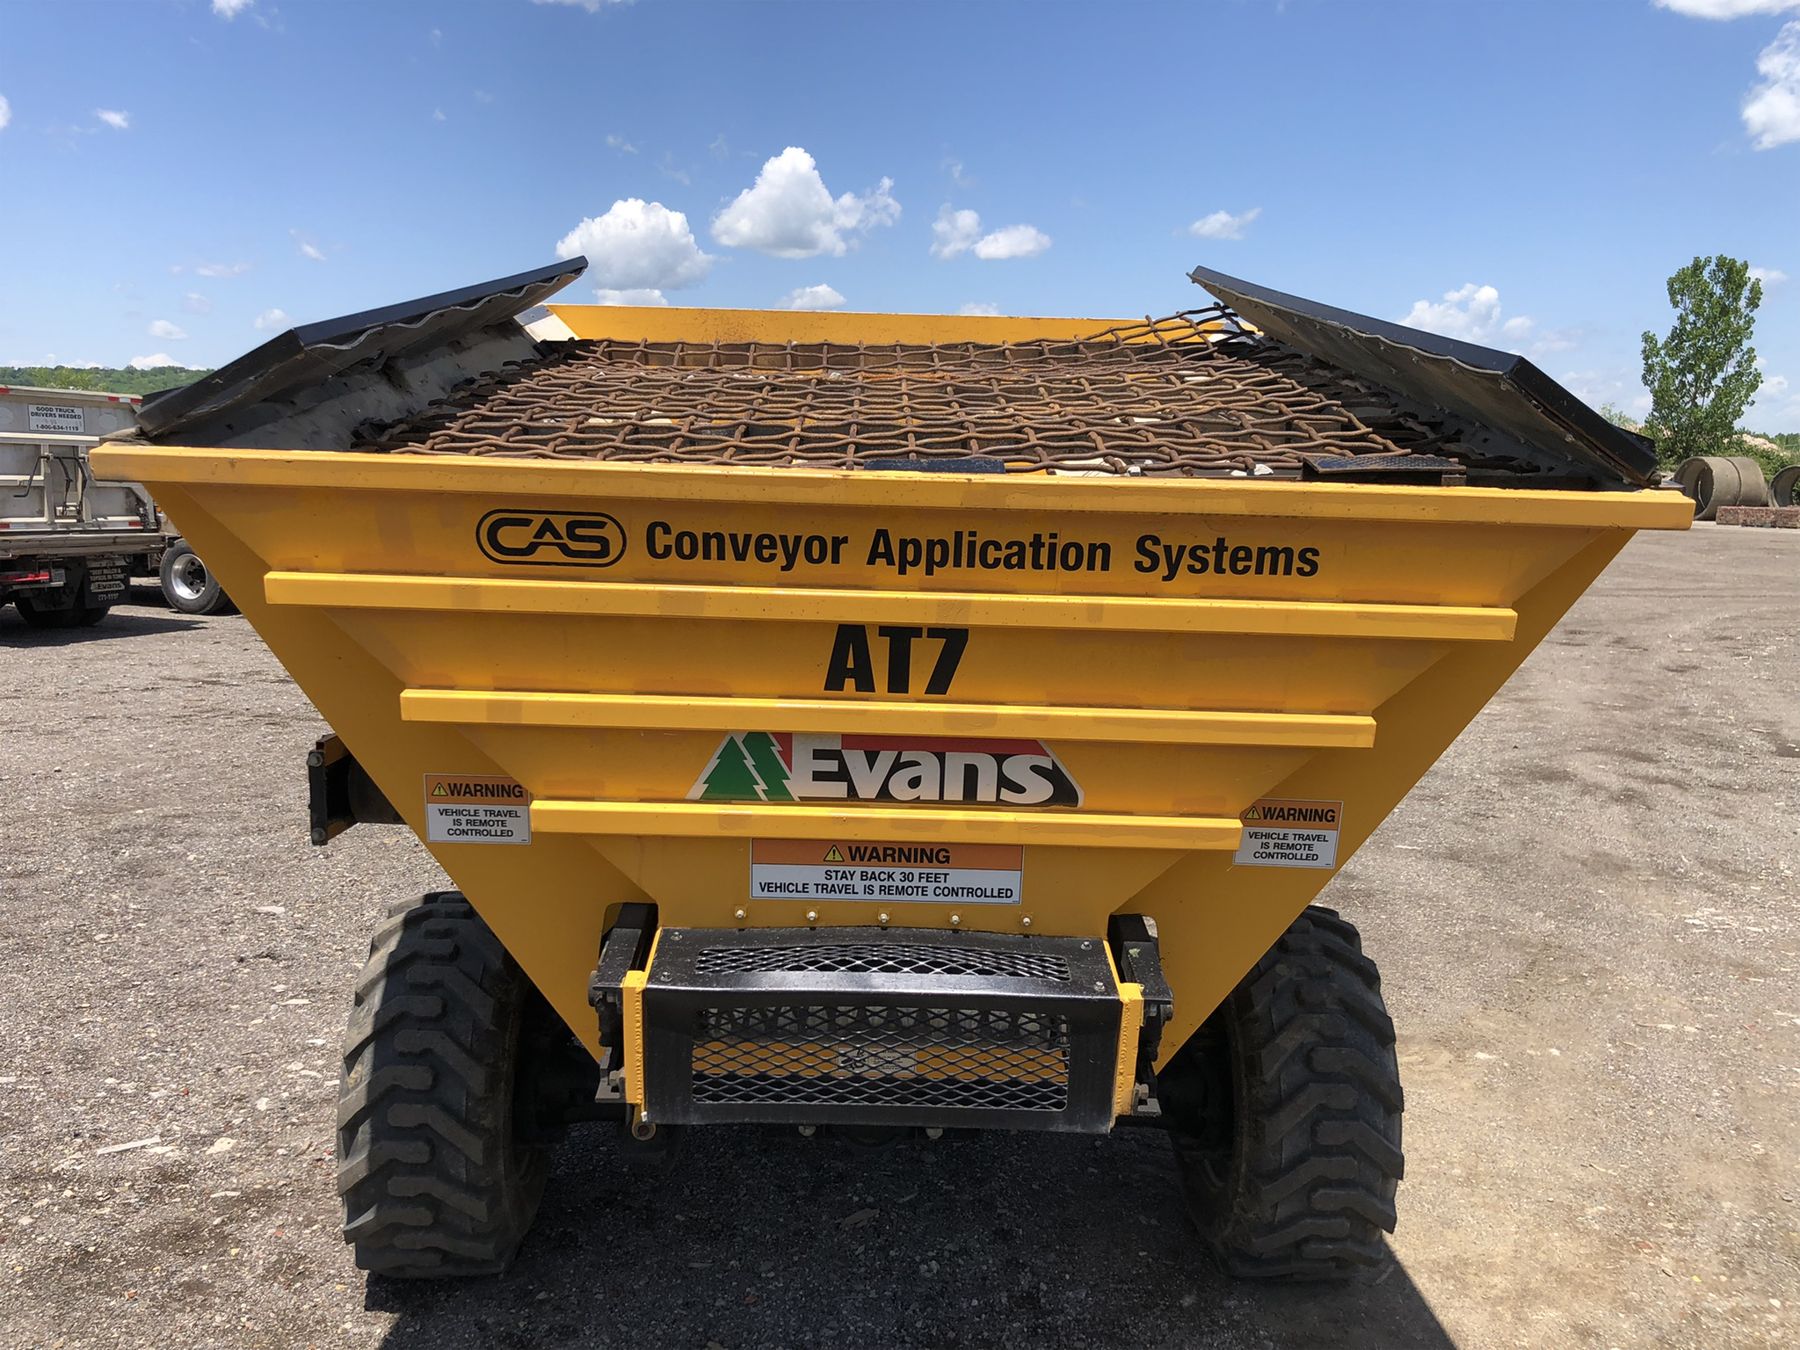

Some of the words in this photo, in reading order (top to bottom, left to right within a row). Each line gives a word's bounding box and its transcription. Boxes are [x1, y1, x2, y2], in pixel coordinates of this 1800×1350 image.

[486, 517, 611, 559] CAS
[646, 521, 848, 571] Conveyor
[866, 528, 1112, 575] Application
[1134, 534, 1320, 582] Systems
[824, 624, 969, 695] AT7
[792, 735, 1054, 804] Evans
[448, 783, 524, 798] WARNING
[438, 808, 480, 817] VEHICLE
[483, 809, 521, 818] TRAVEL
[1262, 806, 1336, 822] WARNING
[466, 819, 508, 828] REMOTE
[447, 828, 514, 837] CONTROLLED
[1248, 831, 1289, 840] VEHICLE
[1292, 833, 1329, 843] TRAVEL
[1273, 842, 1314, 851] REMOTE
[848, 846, 951, 864] WARNING
[1253, 851, 1319, 861] CONTROLLED
[824, 869, 856, 881] STAY
[860, 870, 896, 882] BACK
[899, 871, 914, 883] 30
[918, 872, 950, 883] FEET
[759, 882, 809, 893] VEHICLE
[813, 883, 859, 894] TRAVEL
[863, 884, 875, 895] IS
[879, 885, 929, 896] REMOTE
[933, 886, 1014, 899] CONTROLLED
